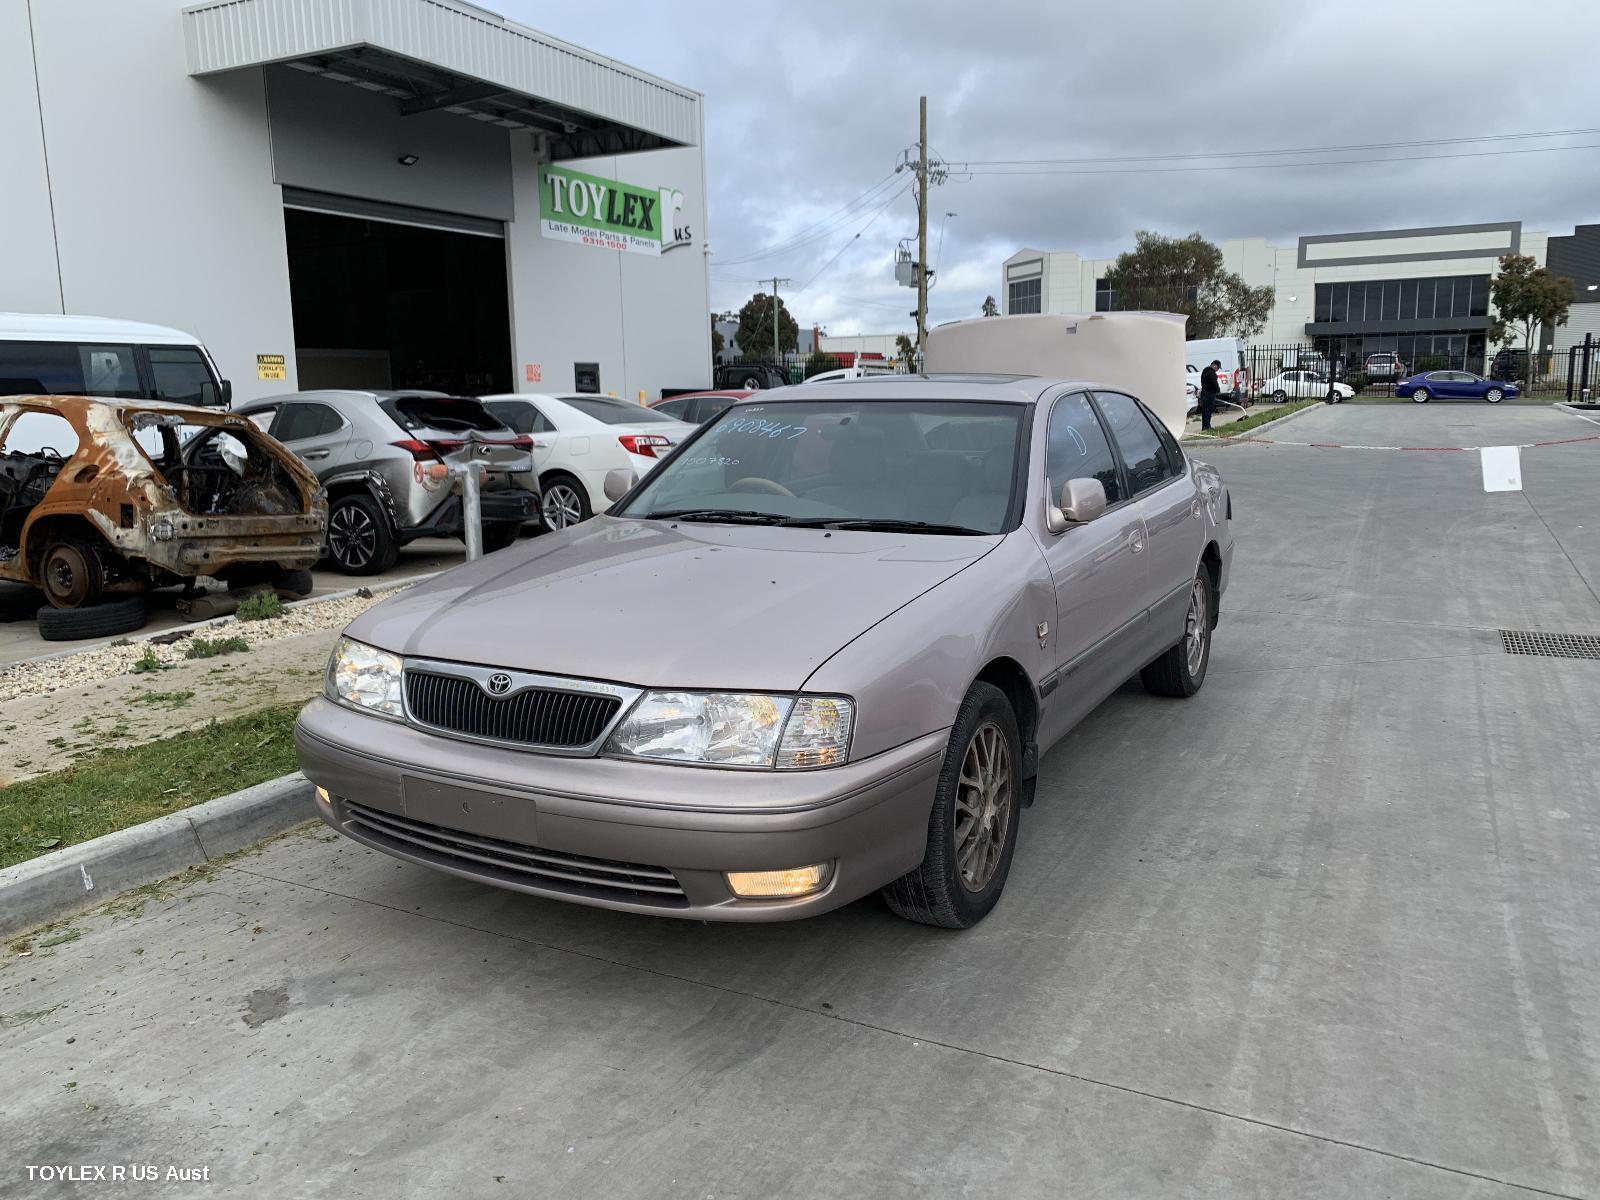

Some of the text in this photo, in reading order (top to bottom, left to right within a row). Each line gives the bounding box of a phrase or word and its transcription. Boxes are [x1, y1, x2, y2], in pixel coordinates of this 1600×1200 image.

[546, 173, 657, 231] TOYLEX
[549, 221, 655, 249] Late Model Parts & Panels
[582, 236, 627, 250] 9315 1500
